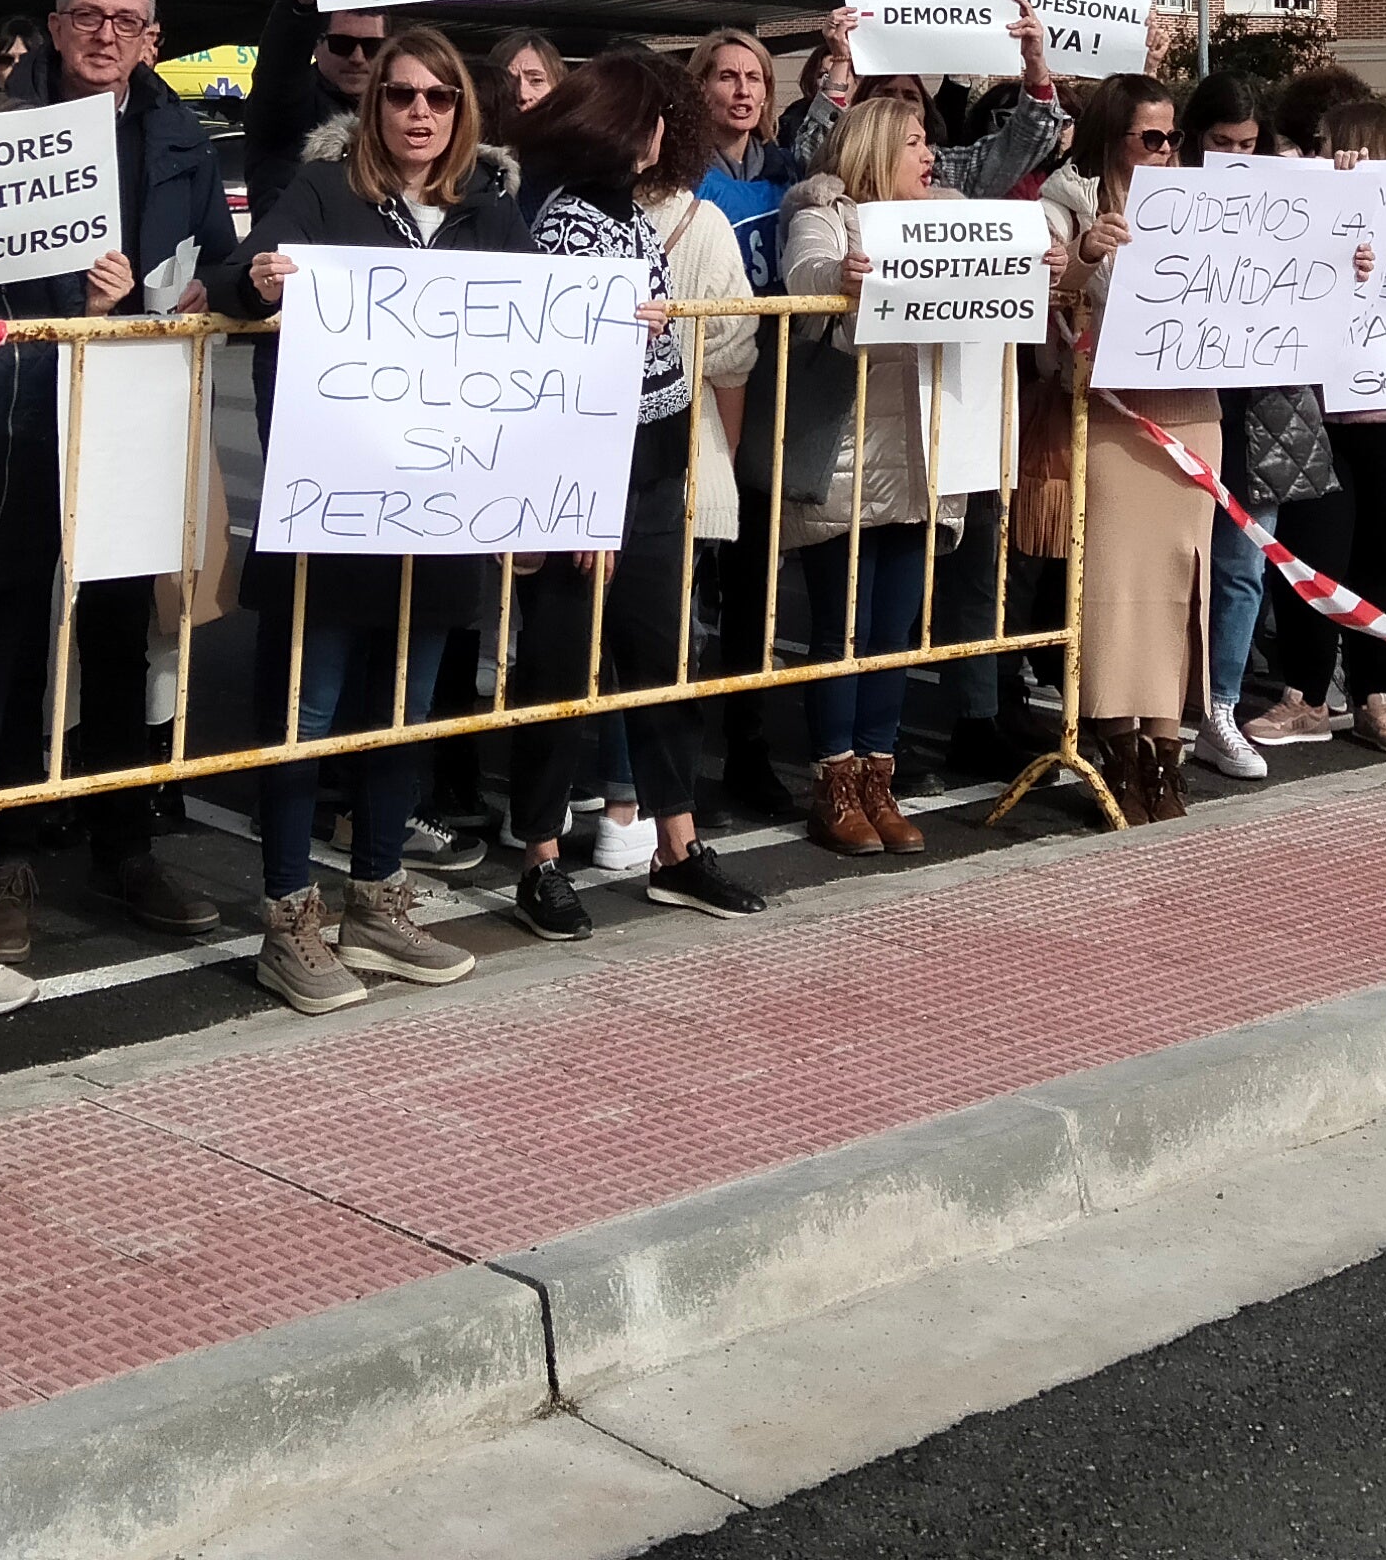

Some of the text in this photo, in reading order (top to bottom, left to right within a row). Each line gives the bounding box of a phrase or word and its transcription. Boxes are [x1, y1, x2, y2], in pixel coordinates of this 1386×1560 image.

[883, 6, 993, 25] DEMORAS
[1046, 26, 1083, 52] YA
[901, 222, 1014, 243] MEJORES
[1331, 211, 1367, 238] LA
[882, 256, 1032, 279] HOSPITALES
[904, 298, 1035, 321] RECURSOS
[317, 361, 618, 416] COLOSAL
[279, 474, 621, 543] PERSONAL
